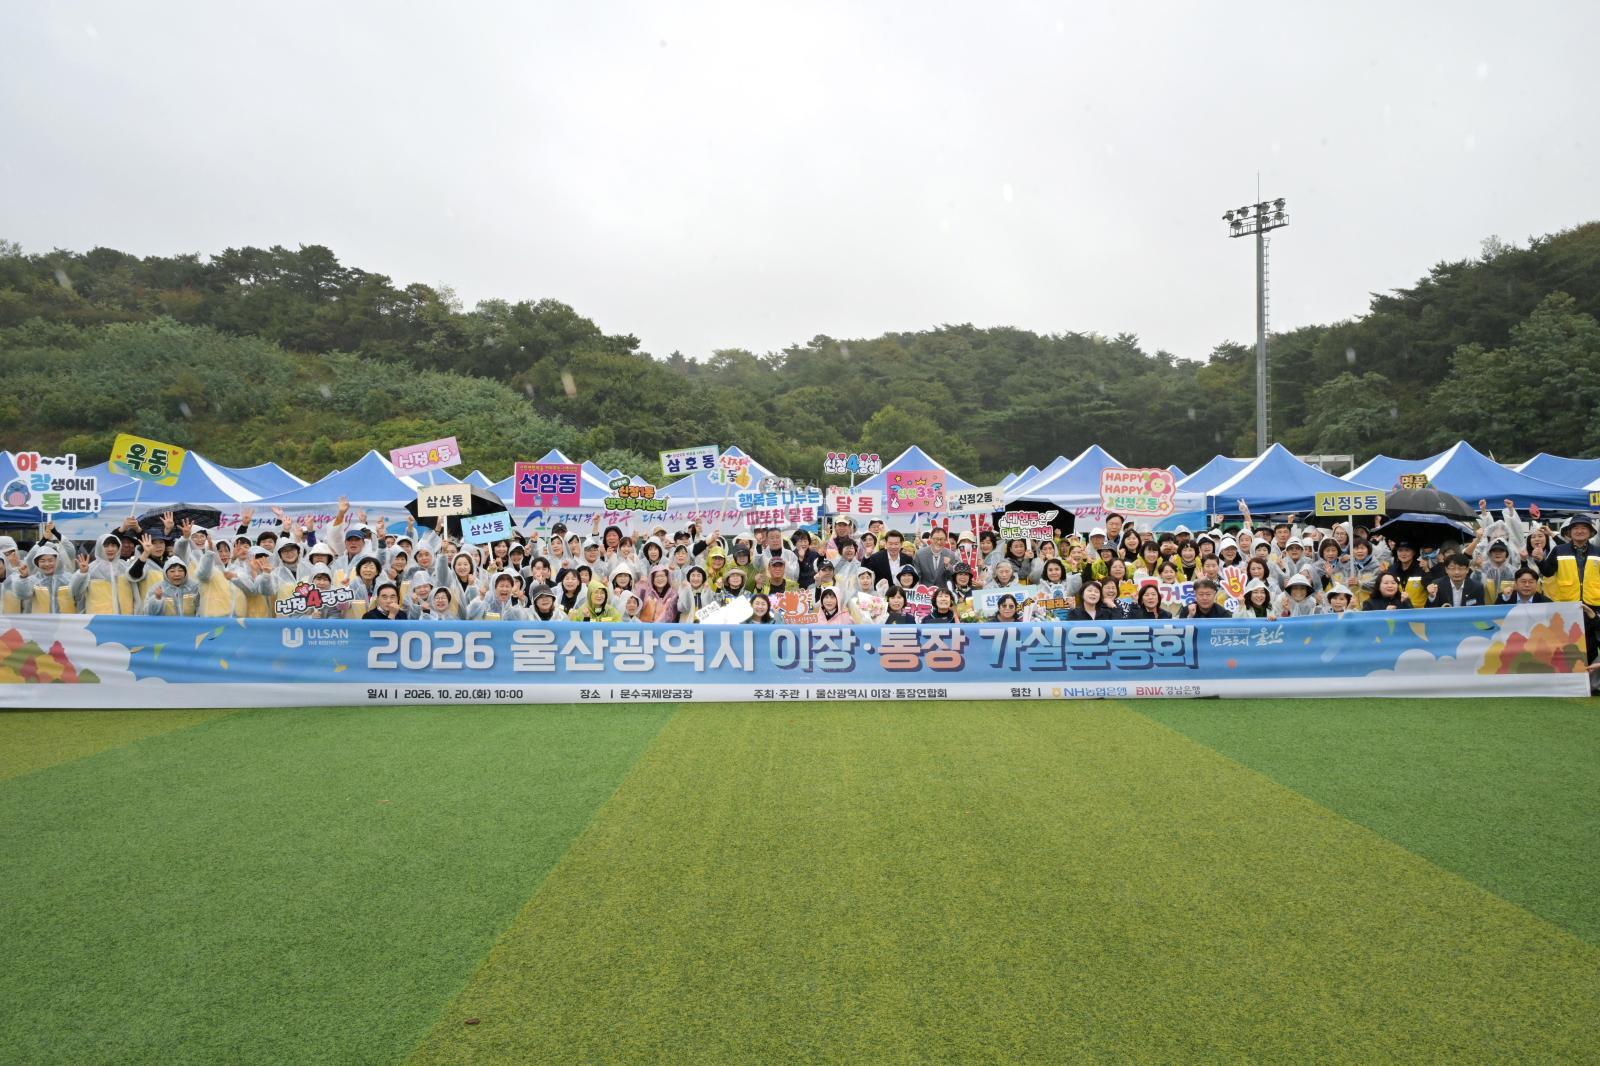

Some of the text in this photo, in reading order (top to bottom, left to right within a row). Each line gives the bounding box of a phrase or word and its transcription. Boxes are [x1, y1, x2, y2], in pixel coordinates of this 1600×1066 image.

[126, 443, 169, 475] 옥동
[519, 473, 577, 494] 선암동
[1105, 473, 1144, 483] HAPPY
[1104, 484, 1144, 494] HAPPY
[426, 494, 463, 508] 삼산동
[738, 492, 778, 508] 행복을
[782, 490, 820, 505] 나누는
[958, 492, 993, 505] 신정2동
[1322, 495, 1378, 511] 신정5동
[470, 520, 504, 536] 삼산동
[1229, 577, 1241, 593] 5
[307, 629, 349, 638] ULSAN
[367, 630, 495, 670] 2026
[510, 629, 755, 673] 울산광역시
[367, 688, 388, 699] 일시
[404, 688, 434, 699] 2026.
[438, 688, 452, 699] 10.
[495, 688, 524, 699] 10:00
[580, 688, 693, 699] 장소 문수국제양궁장
[753, 688, 800, 699] 주최·주관
[816, 688, 868, 699] 울산광역시
[1010, 687, 1032, 697] 협찬
[1135, 686, 1164, 696] BNK
[1165, 685, 1201, 696] 경남은행
